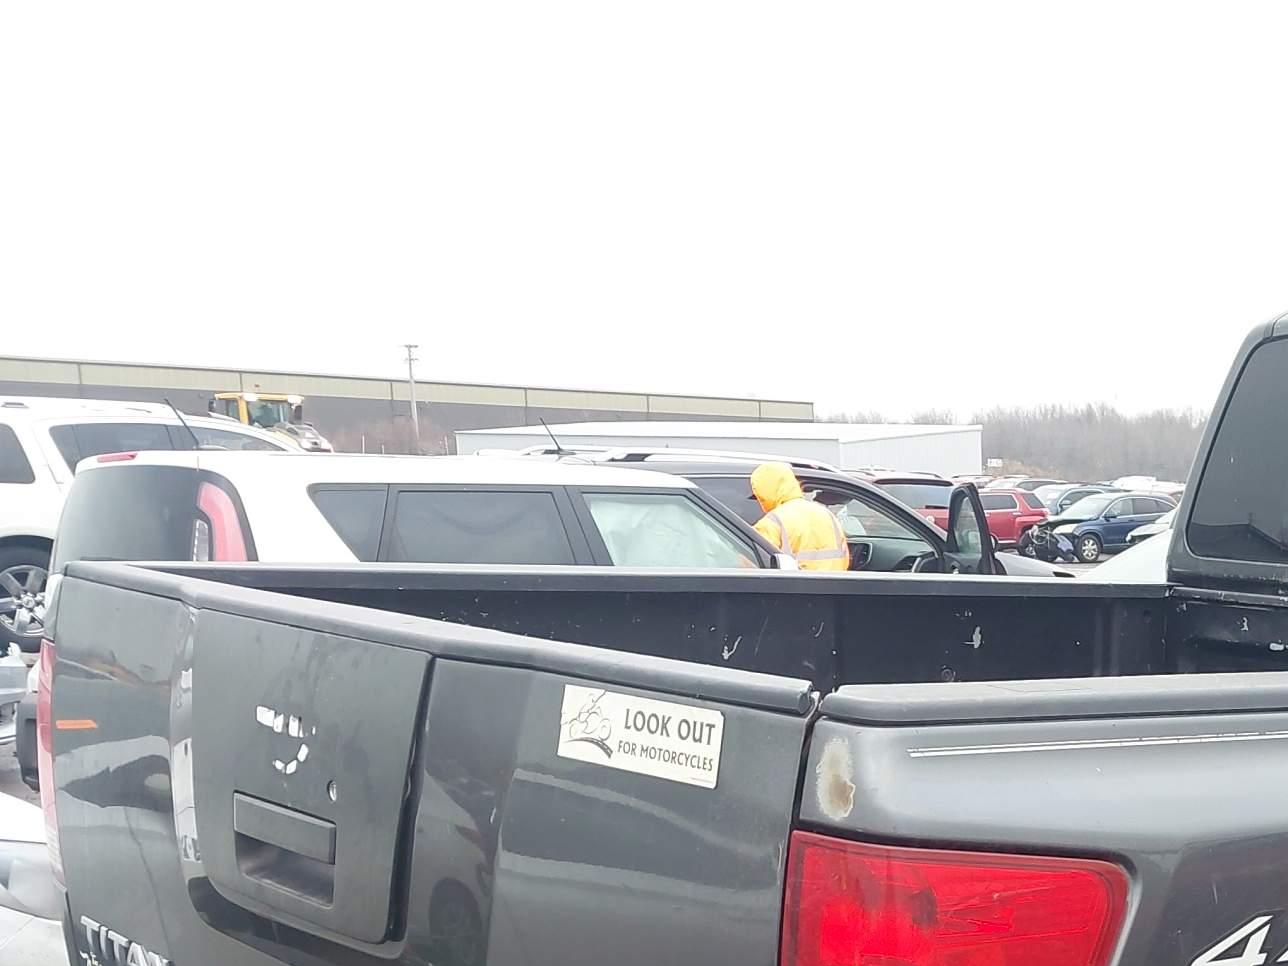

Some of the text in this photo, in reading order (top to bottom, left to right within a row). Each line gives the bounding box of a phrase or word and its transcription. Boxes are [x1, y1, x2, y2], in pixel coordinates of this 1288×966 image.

[624, 708, 716, 745] LOOK OUT
[617, 740, 714, 772] FOR MOTORCYCLES
